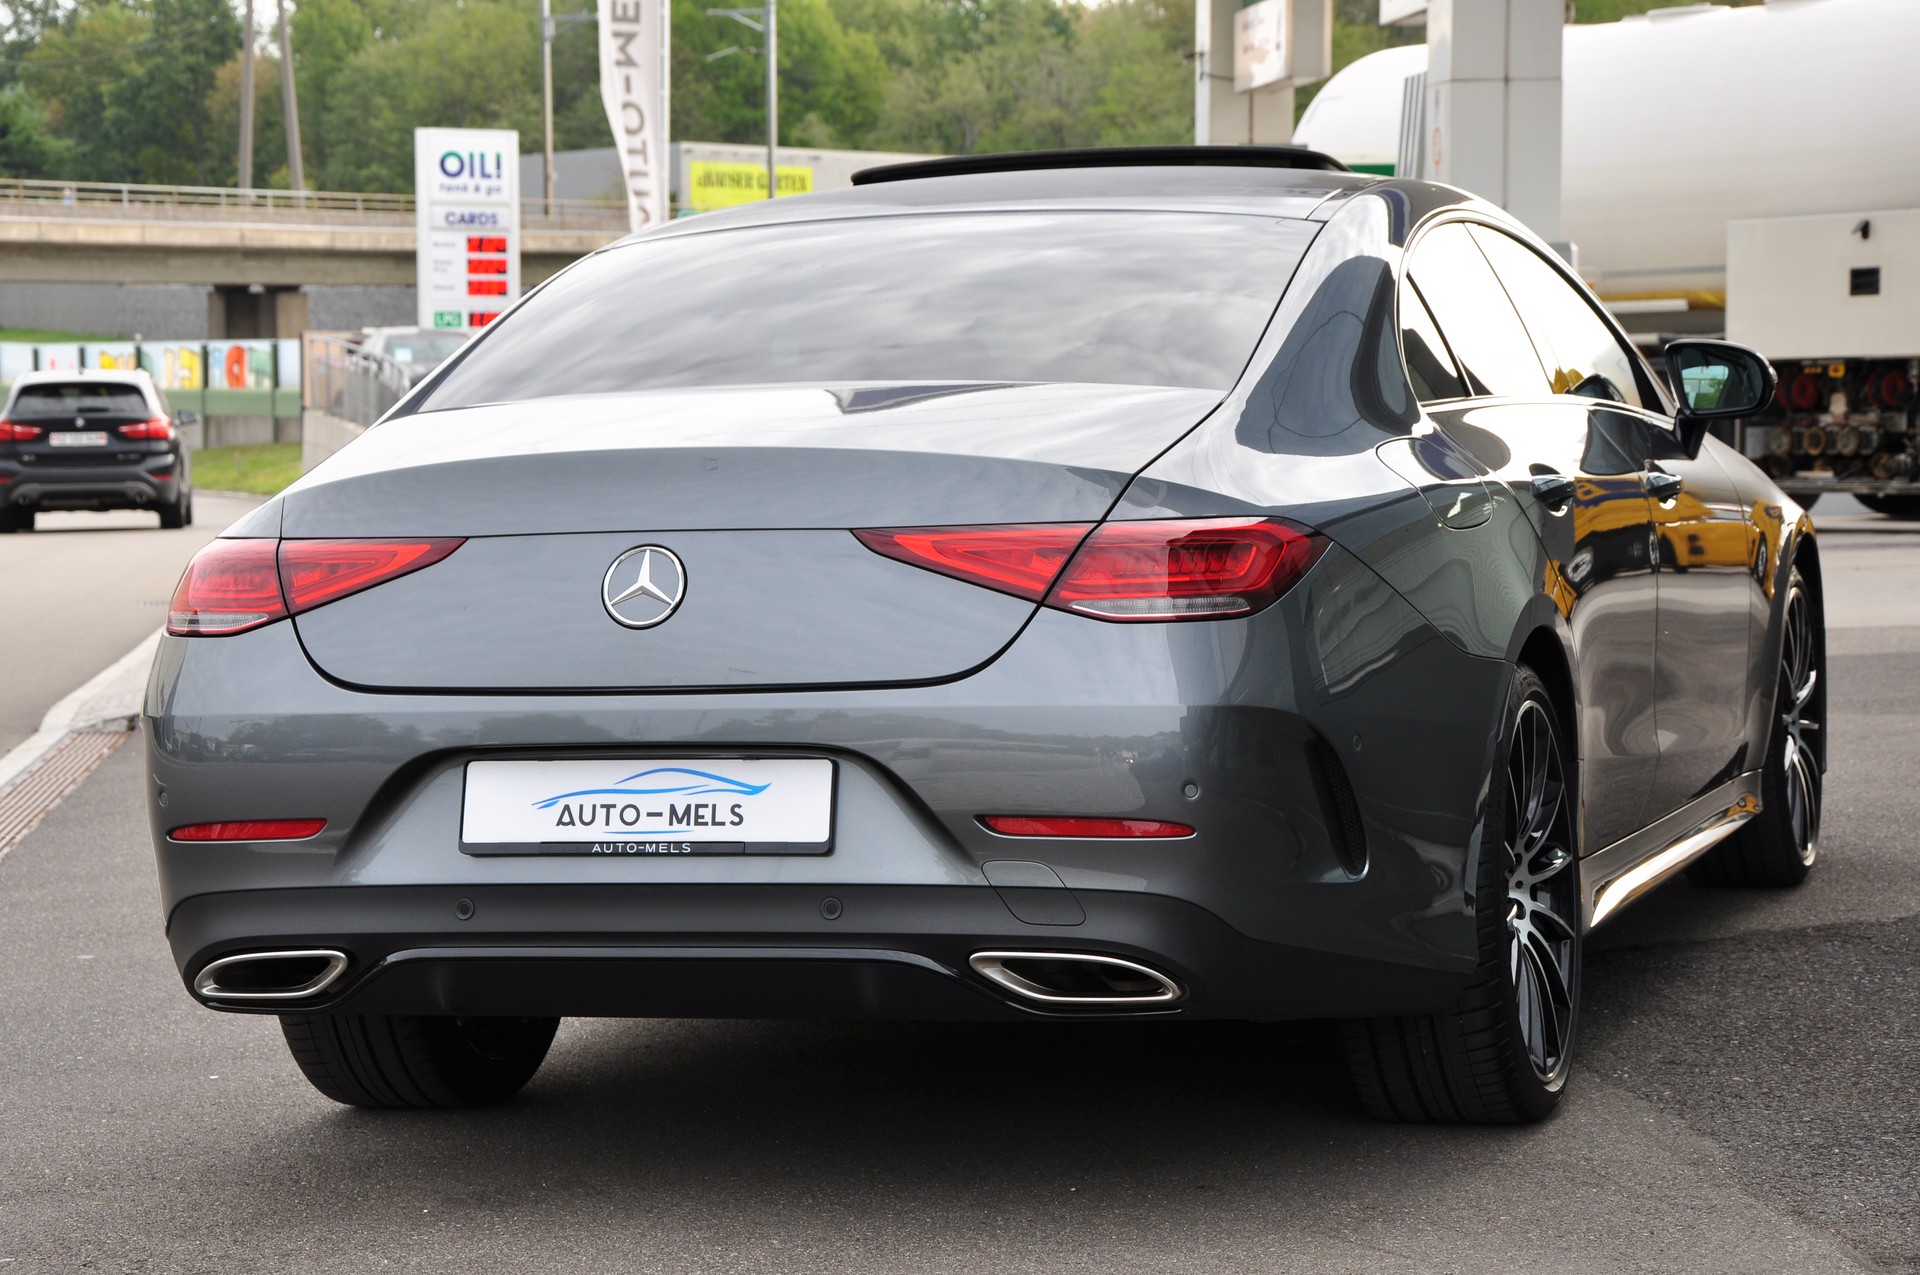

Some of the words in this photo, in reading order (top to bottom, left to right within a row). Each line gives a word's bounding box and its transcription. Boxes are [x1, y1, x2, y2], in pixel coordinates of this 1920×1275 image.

[440, 151, 502, 178] OIL!
[444, 211, 498, 225] CARDS
[555, 803, 744, 827] AUTO-MELS
[592, 843, 691, 853] AUTO-MELS
